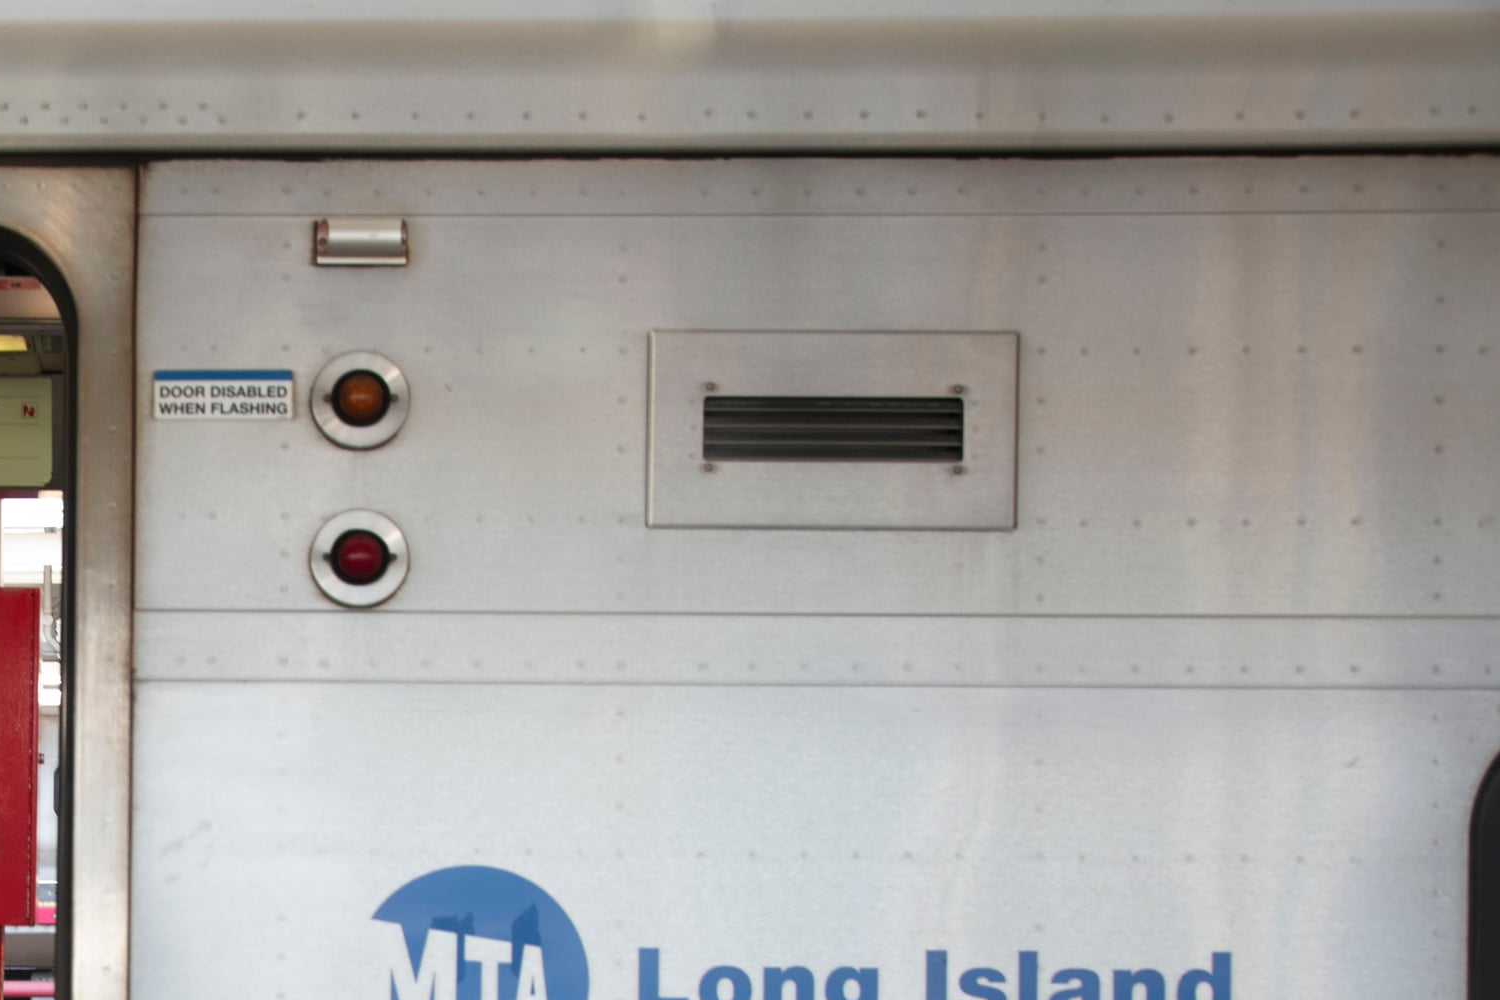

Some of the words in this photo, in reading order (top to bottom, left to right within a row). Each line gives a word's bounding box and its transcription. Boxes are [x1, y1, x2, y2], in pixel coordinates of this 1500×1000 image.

[159, 386, 206, 398] DOOR
[210, 386, 288, 398] DISABLED
[159, 402, 206, 415] WHEN
[210, 402, 288, 415] FLASHING
